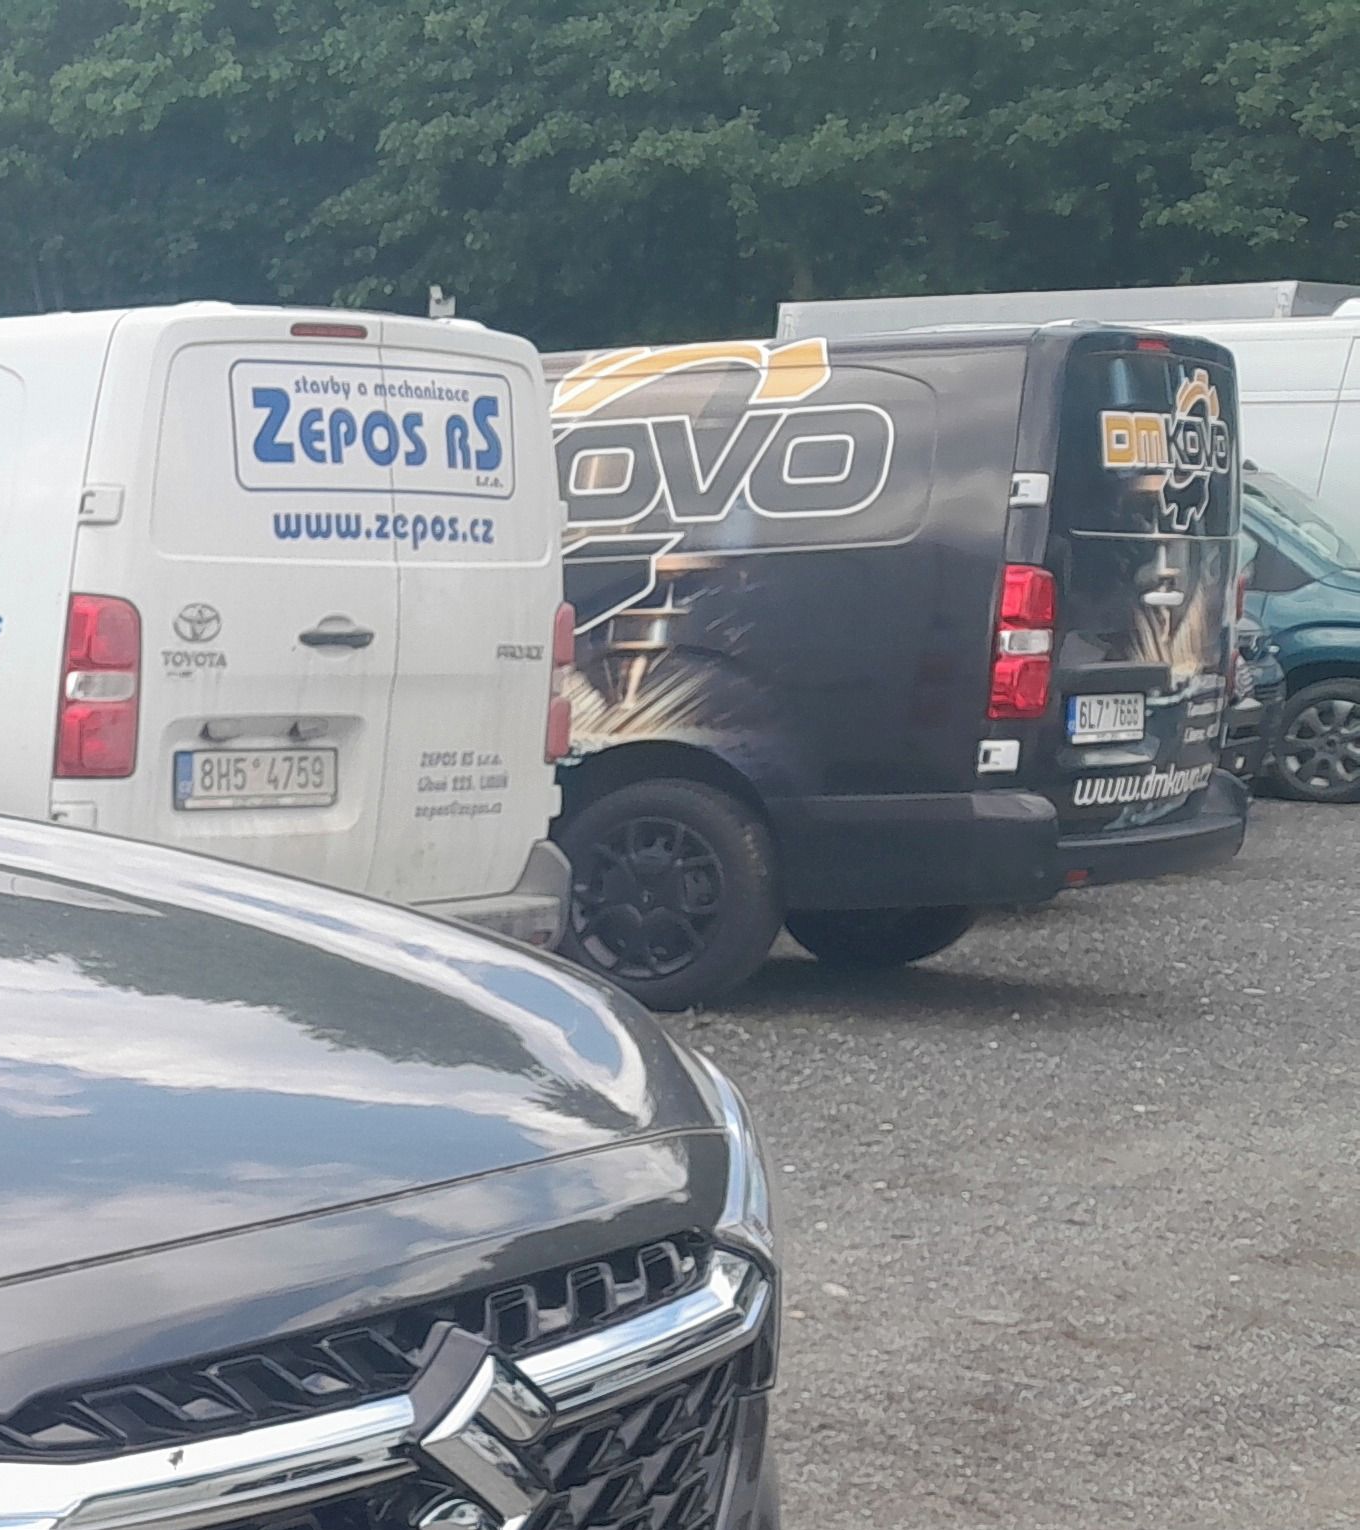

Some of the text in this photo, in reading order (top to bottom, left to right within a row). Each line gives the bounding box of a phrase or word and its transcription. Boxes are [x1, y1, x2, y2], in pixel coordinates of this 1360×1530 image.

[294, 376, 470, 402] stavby a mechanizace
[251, 386, 503, 472] ZEPOS RS
[273, 512, 495, 551] www.zepos.cz
[161, 651, 228, 669] TOYOTA
